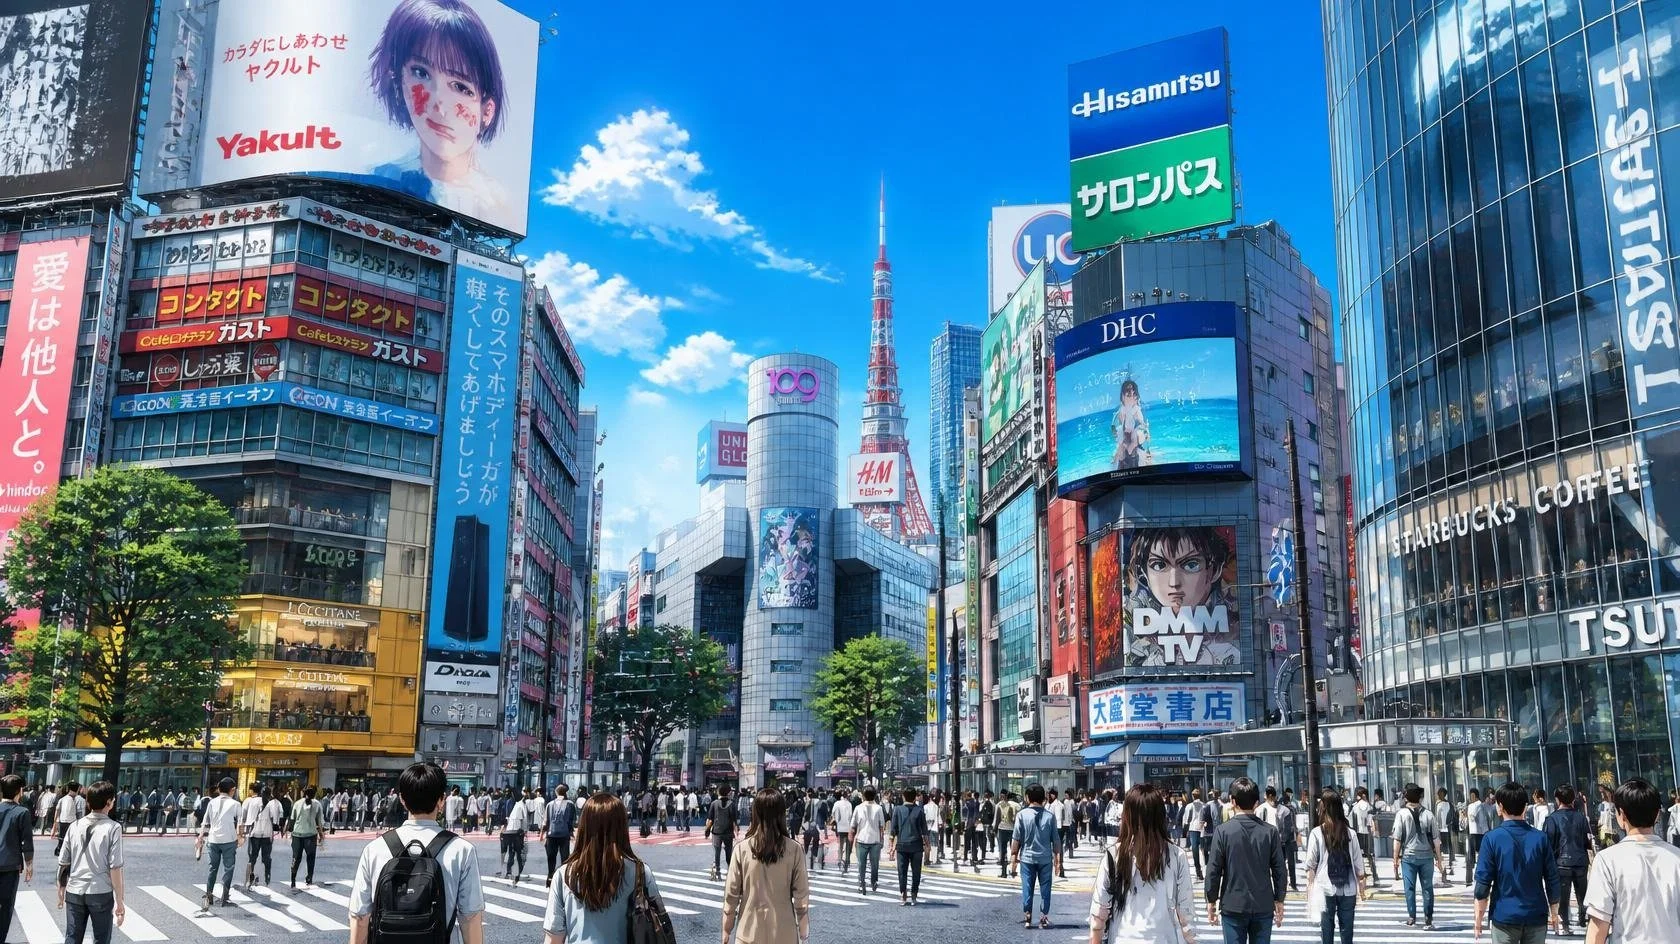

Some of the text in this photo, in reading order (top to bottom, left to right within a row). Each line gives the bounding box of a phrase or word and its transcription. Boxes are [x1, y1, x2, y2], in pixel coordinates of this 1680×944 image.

[223, 33, 348, 63] カラダにしあわせ
[1071, 69, 1221, 118] Hisamitsu
[216, 125, 342, 160] Yakult
[1077, 157, 1223, 218] サロンパス
[160, 286, 263, 315] コンタクト
[299, 285, 410, 329] コンタクト
[218, 319, 271, 342] ガスト
[1101, 312, 1157, 344] DHC
[12, 251, 69, 474] 愛は他人と。
[372, 340, 427, 367] ガスト
[767, 367, 820, 402] 109
[1391, 459, 1655, 558] STARBUCKS COFFEE
[1133, 604, 1230, 636] DMM
[1157, 634, 1204, 664] TV
